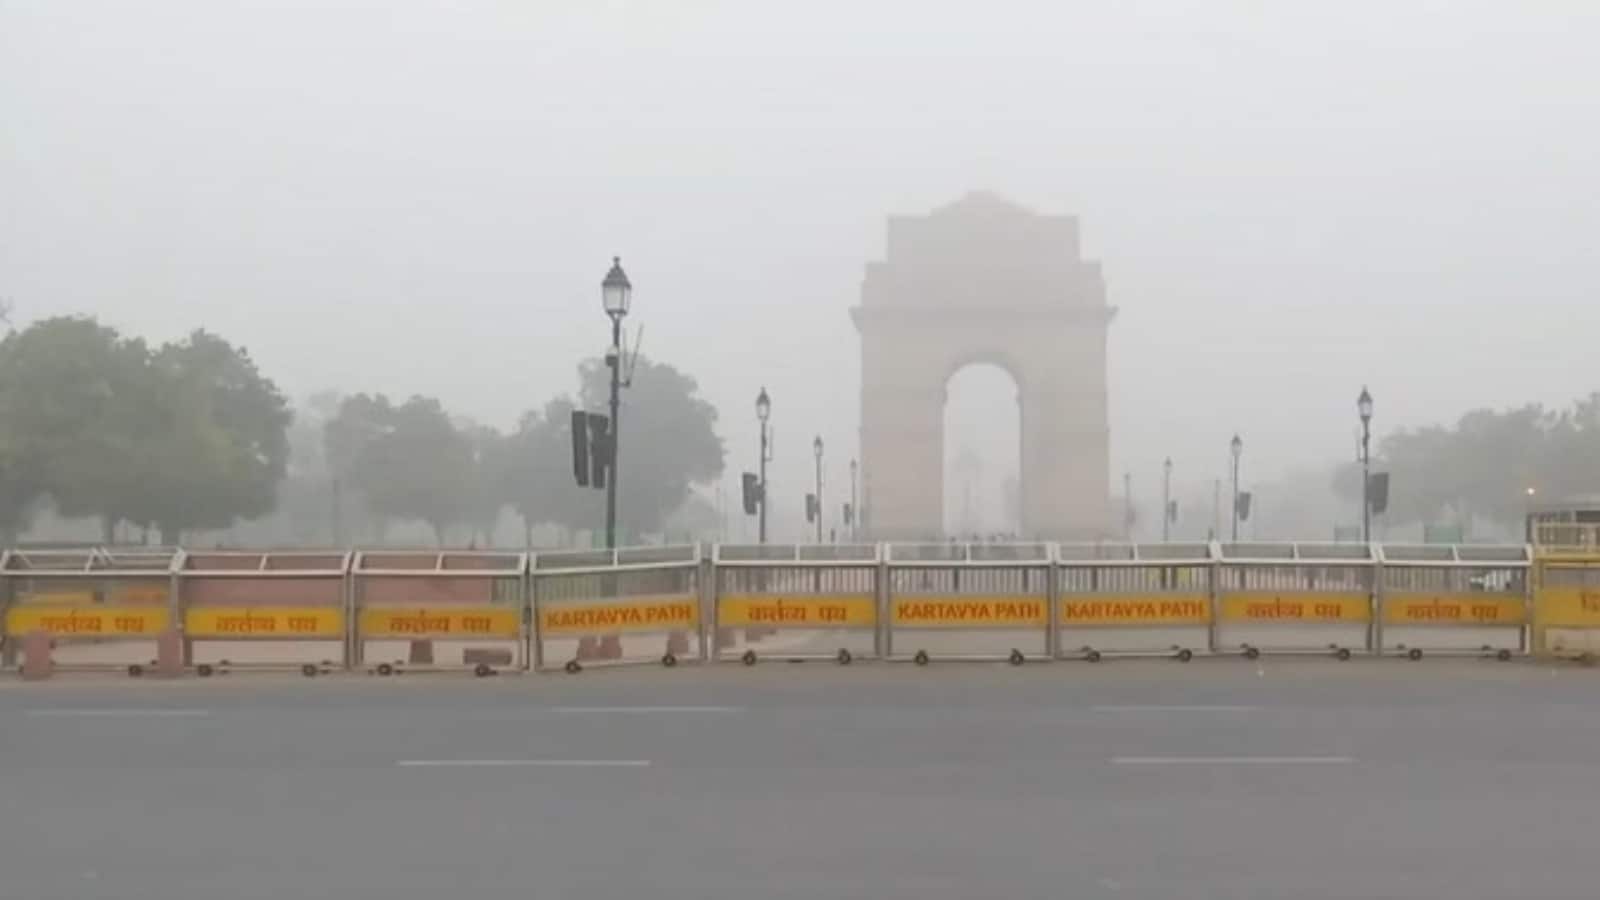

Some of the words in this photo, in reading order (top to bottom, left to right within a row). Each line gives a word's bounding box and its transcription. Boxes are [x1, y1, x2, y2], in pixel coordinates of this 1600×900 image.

[546, 606, 642, 626] KARTAVYA
[645, 603, 692, 621] PATH
[898, 602, 991, 619] KARTAVYA
[995, 602, 1041, 618] PATH
[1065, 601, 1156, 619] KARTAVYA
[1160, 600, 1204, 617] PATH
